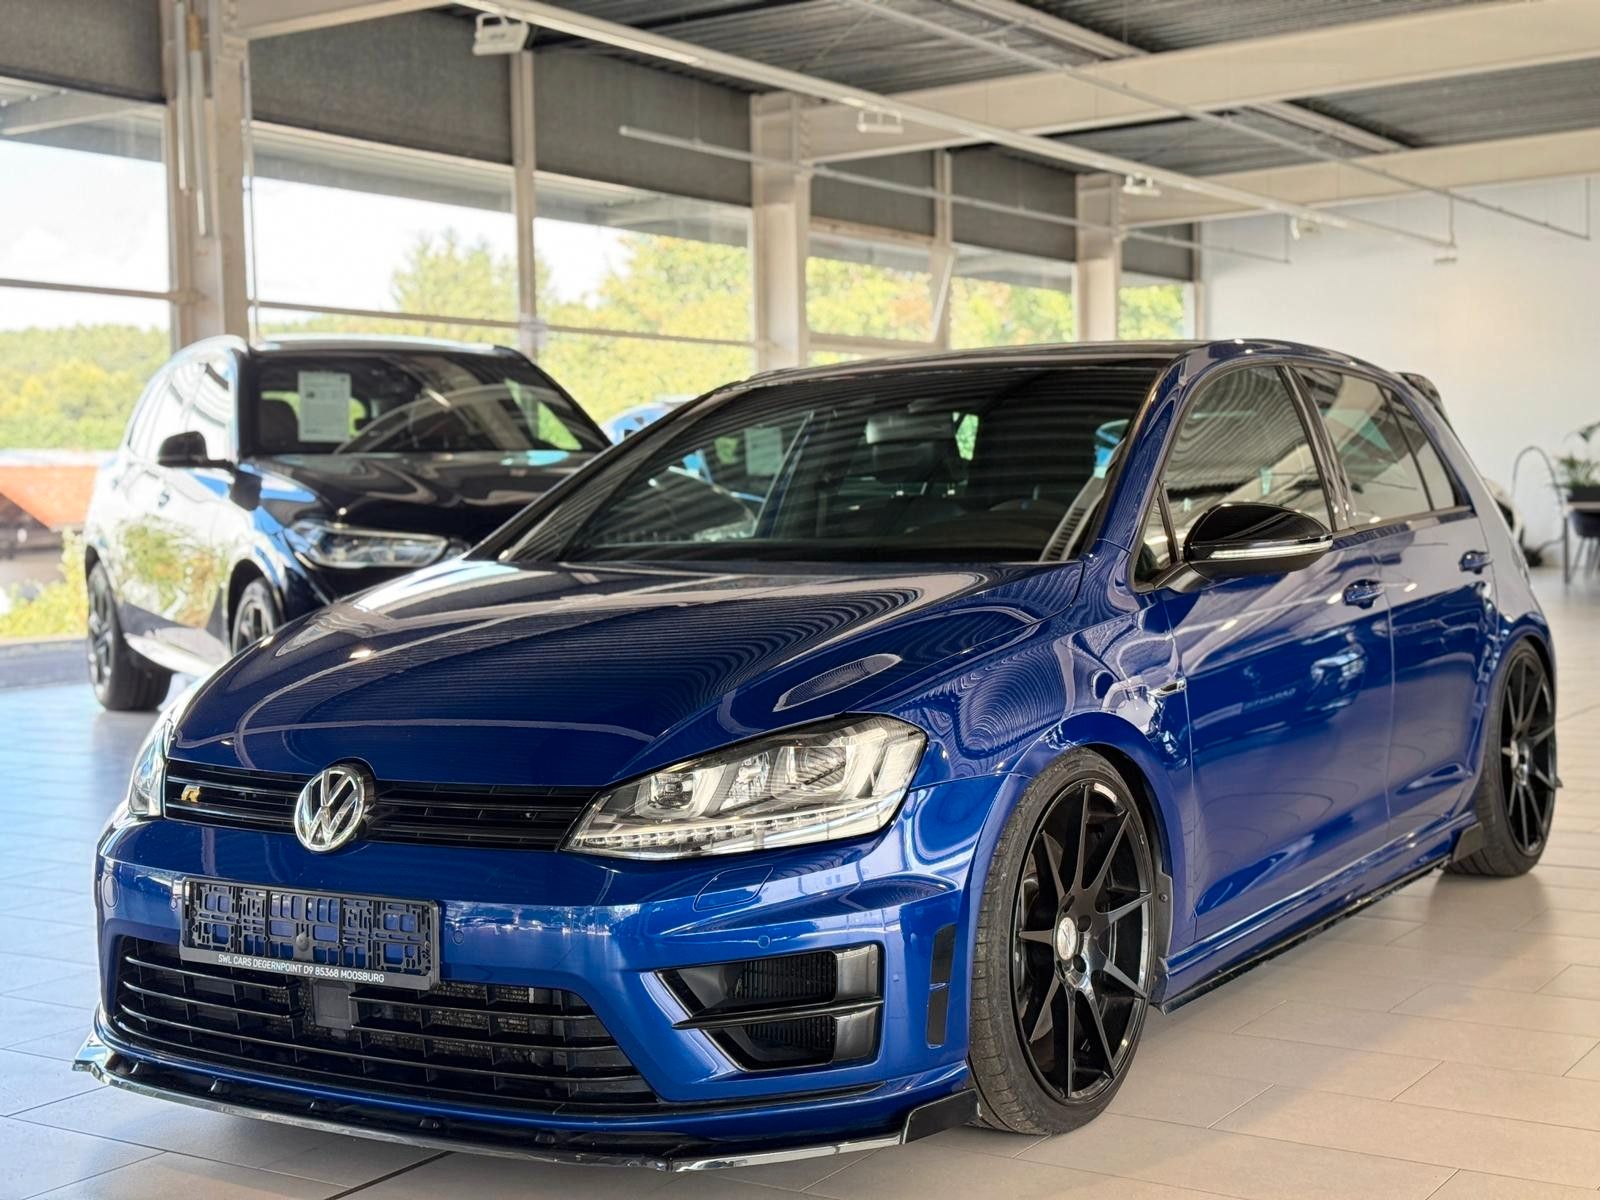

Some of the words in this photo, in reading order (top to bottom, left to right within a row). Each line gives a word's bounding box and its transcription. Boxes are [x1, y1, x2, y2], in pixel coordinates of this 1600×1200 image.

[218, 953, 233, 965] SWL
[233, 956, 252, 967] CARS
[252, 958, 302, 973] DEGERNPOINT
[315, 966, 339, 978] 85368
[340, 969, 385, 983] MOOSBURG
